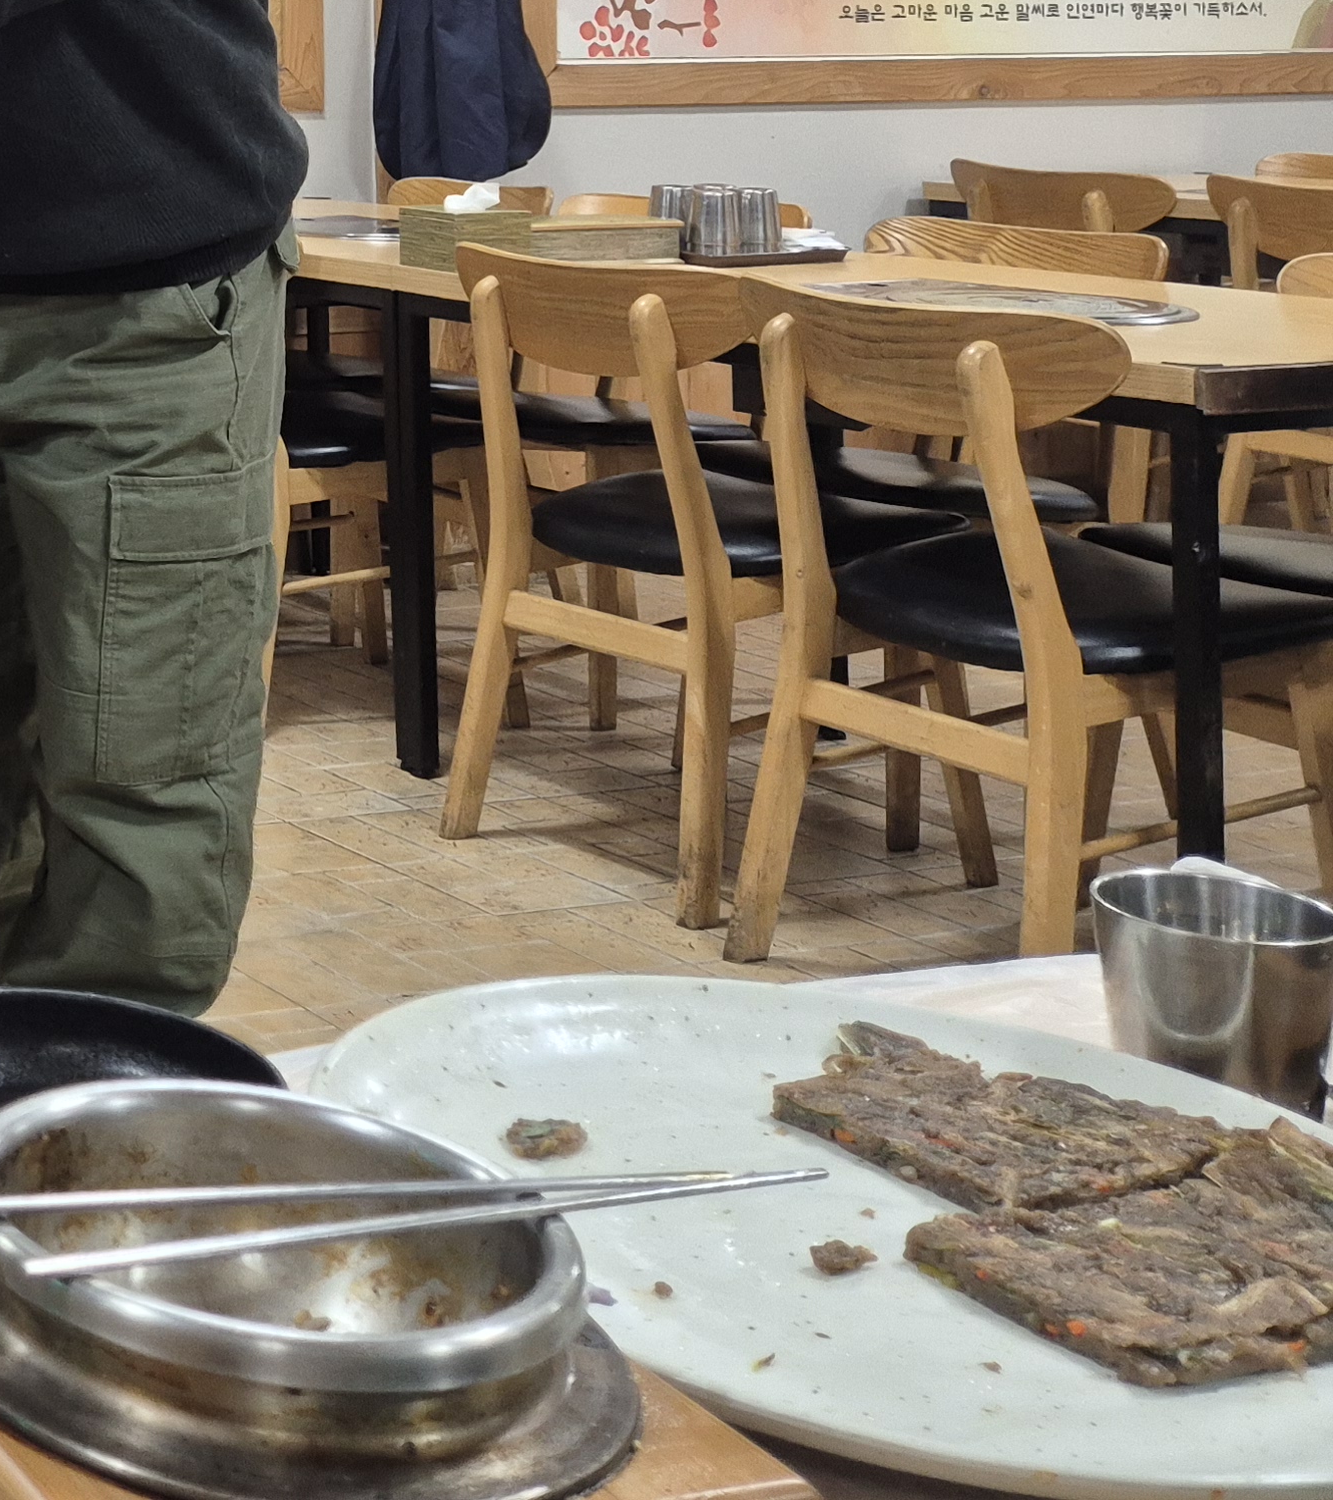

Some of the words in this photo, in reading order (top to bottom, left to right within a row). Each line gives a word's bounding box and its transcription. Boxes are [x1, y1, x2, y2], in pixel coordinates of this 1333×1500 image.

[837, 3, 886, 24] 오늘은
[890, 3, 939, 22] 고마운
[944, 3, 974, 23] 마음
[979, 2, 1010, 22] 고운
[1015, 3, 1061, 22] 말씨로
[1066, 2, 1125, 20] 인연마다
[1130, 2, 1188, 21] 행복꽃이
